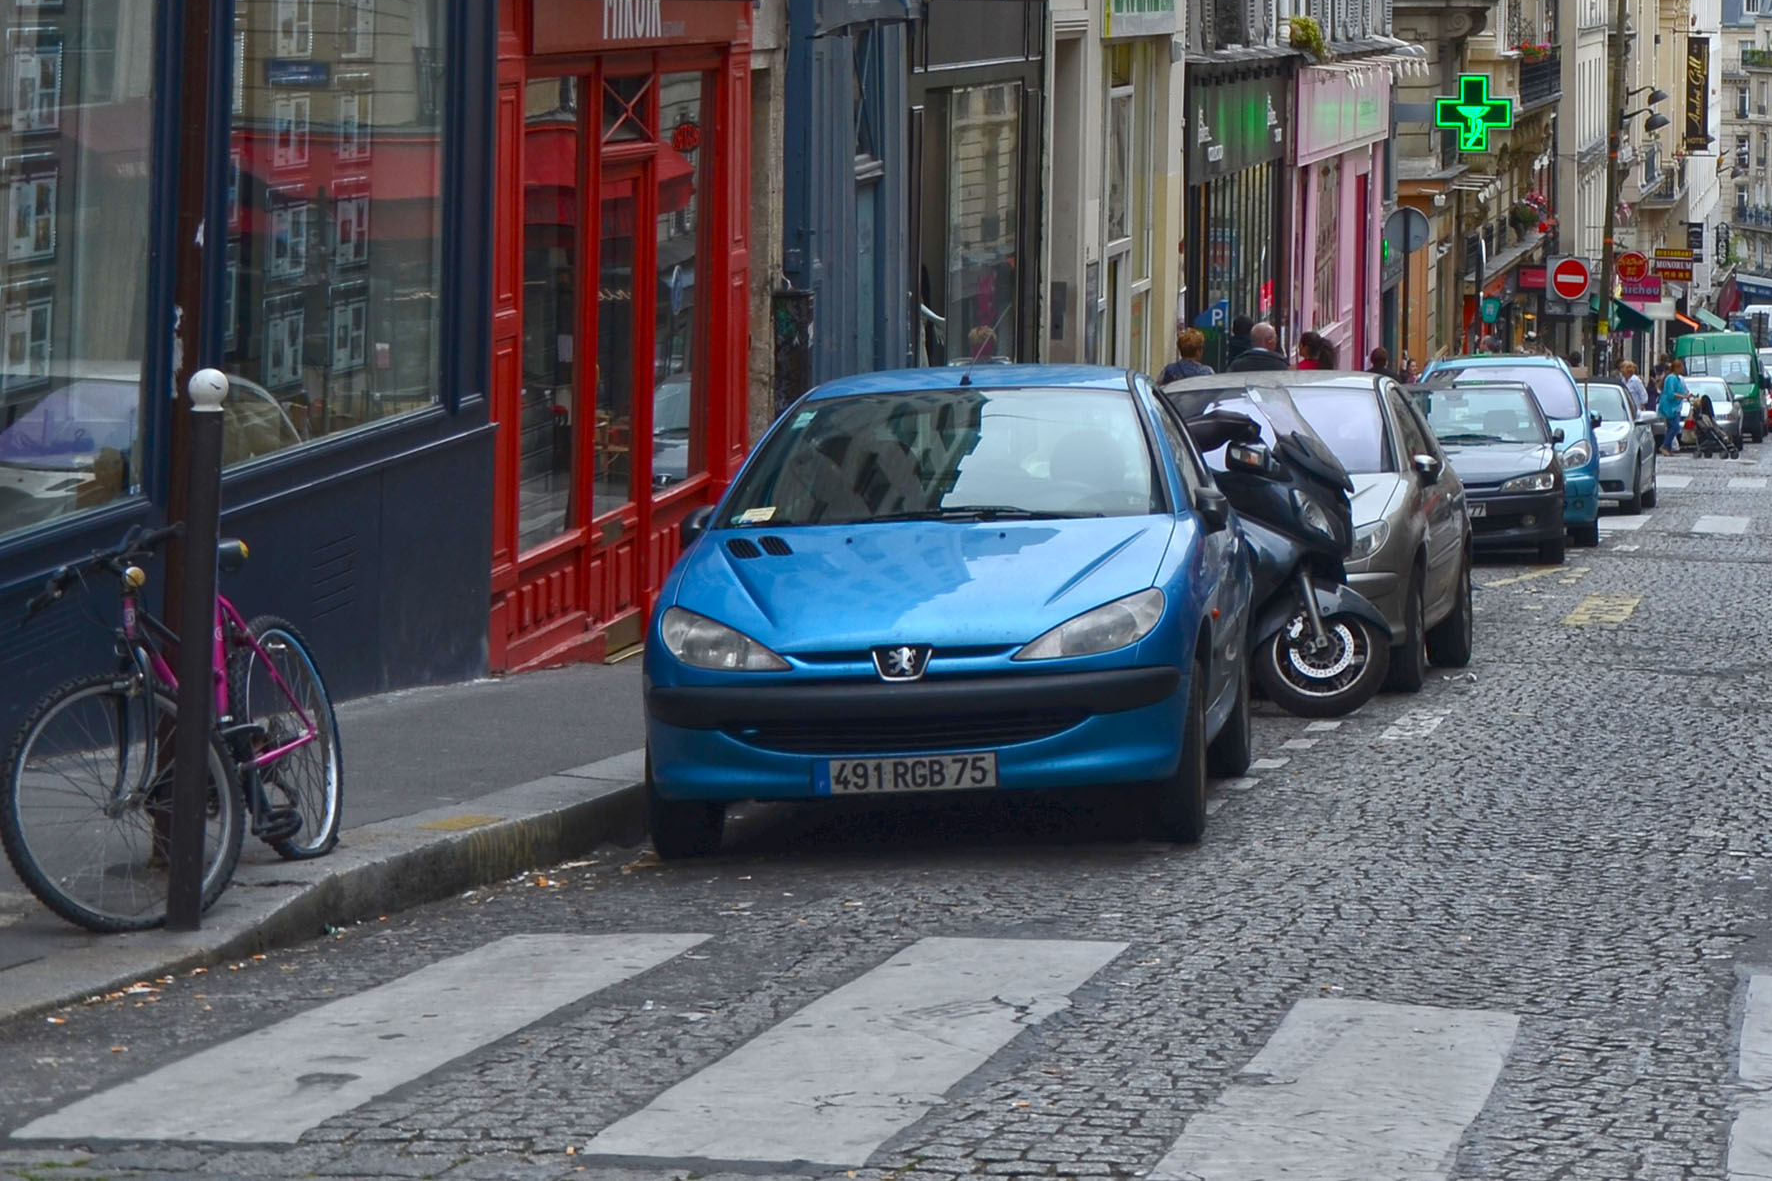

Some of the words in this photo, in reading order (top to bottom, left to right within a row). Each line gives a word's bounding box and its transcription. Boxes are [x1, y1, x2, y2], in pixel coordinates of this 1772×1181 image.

[1211, 308, 1224, 327] P
[1471, 505, 1483, 516] 77
[834, 762, 884, 790] 491
[893, 759, 946, 789] RGB
[952, 756, 987, 786] 75
